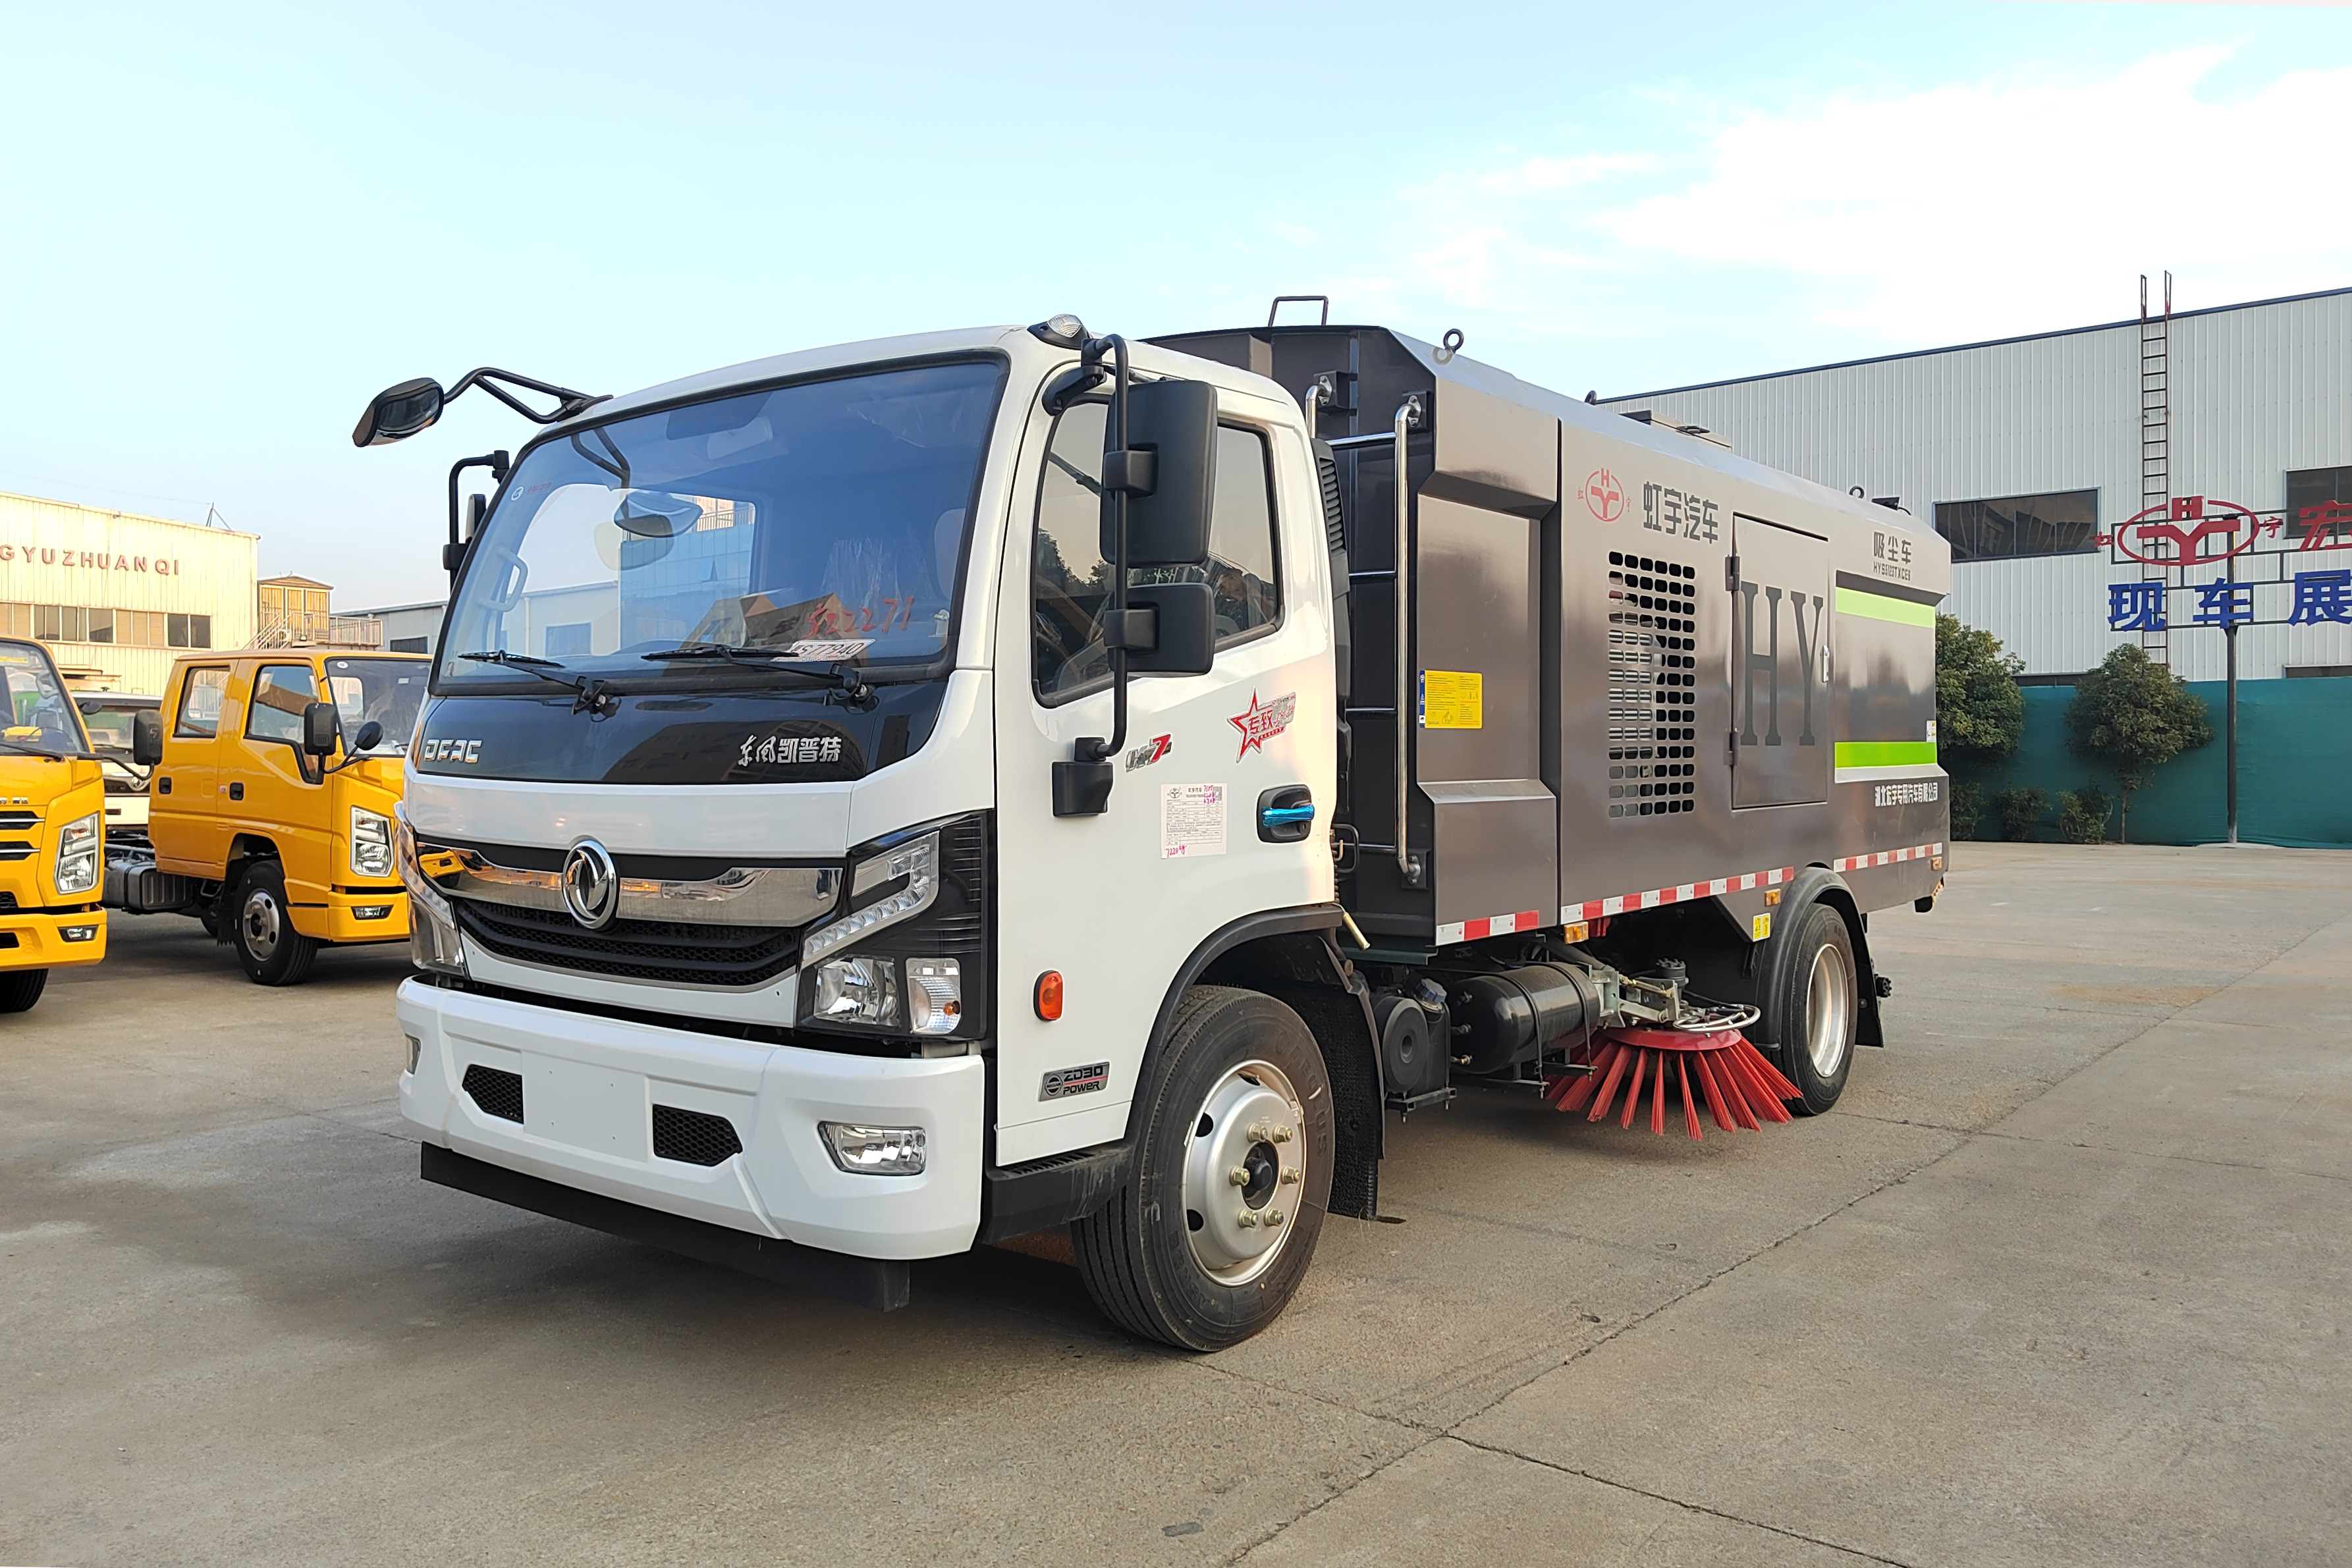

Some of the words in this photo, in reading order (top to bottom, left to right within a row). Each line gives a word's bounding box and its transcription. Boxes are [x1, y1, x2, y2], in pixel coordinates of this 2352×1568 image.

[1643, 481, 1718, 544] 虹宇汽车
[1874, 531, 1911, 565] 吸尘车
[1740, 580, 1824, 746] HY
[424, 739, 483, 763] DFAC
[738, 734, 842, 767] 东风凯普特
[1063, 1081, 1101, 1095] POWER
[1064, 1066, 1103, 1082] ZD30
